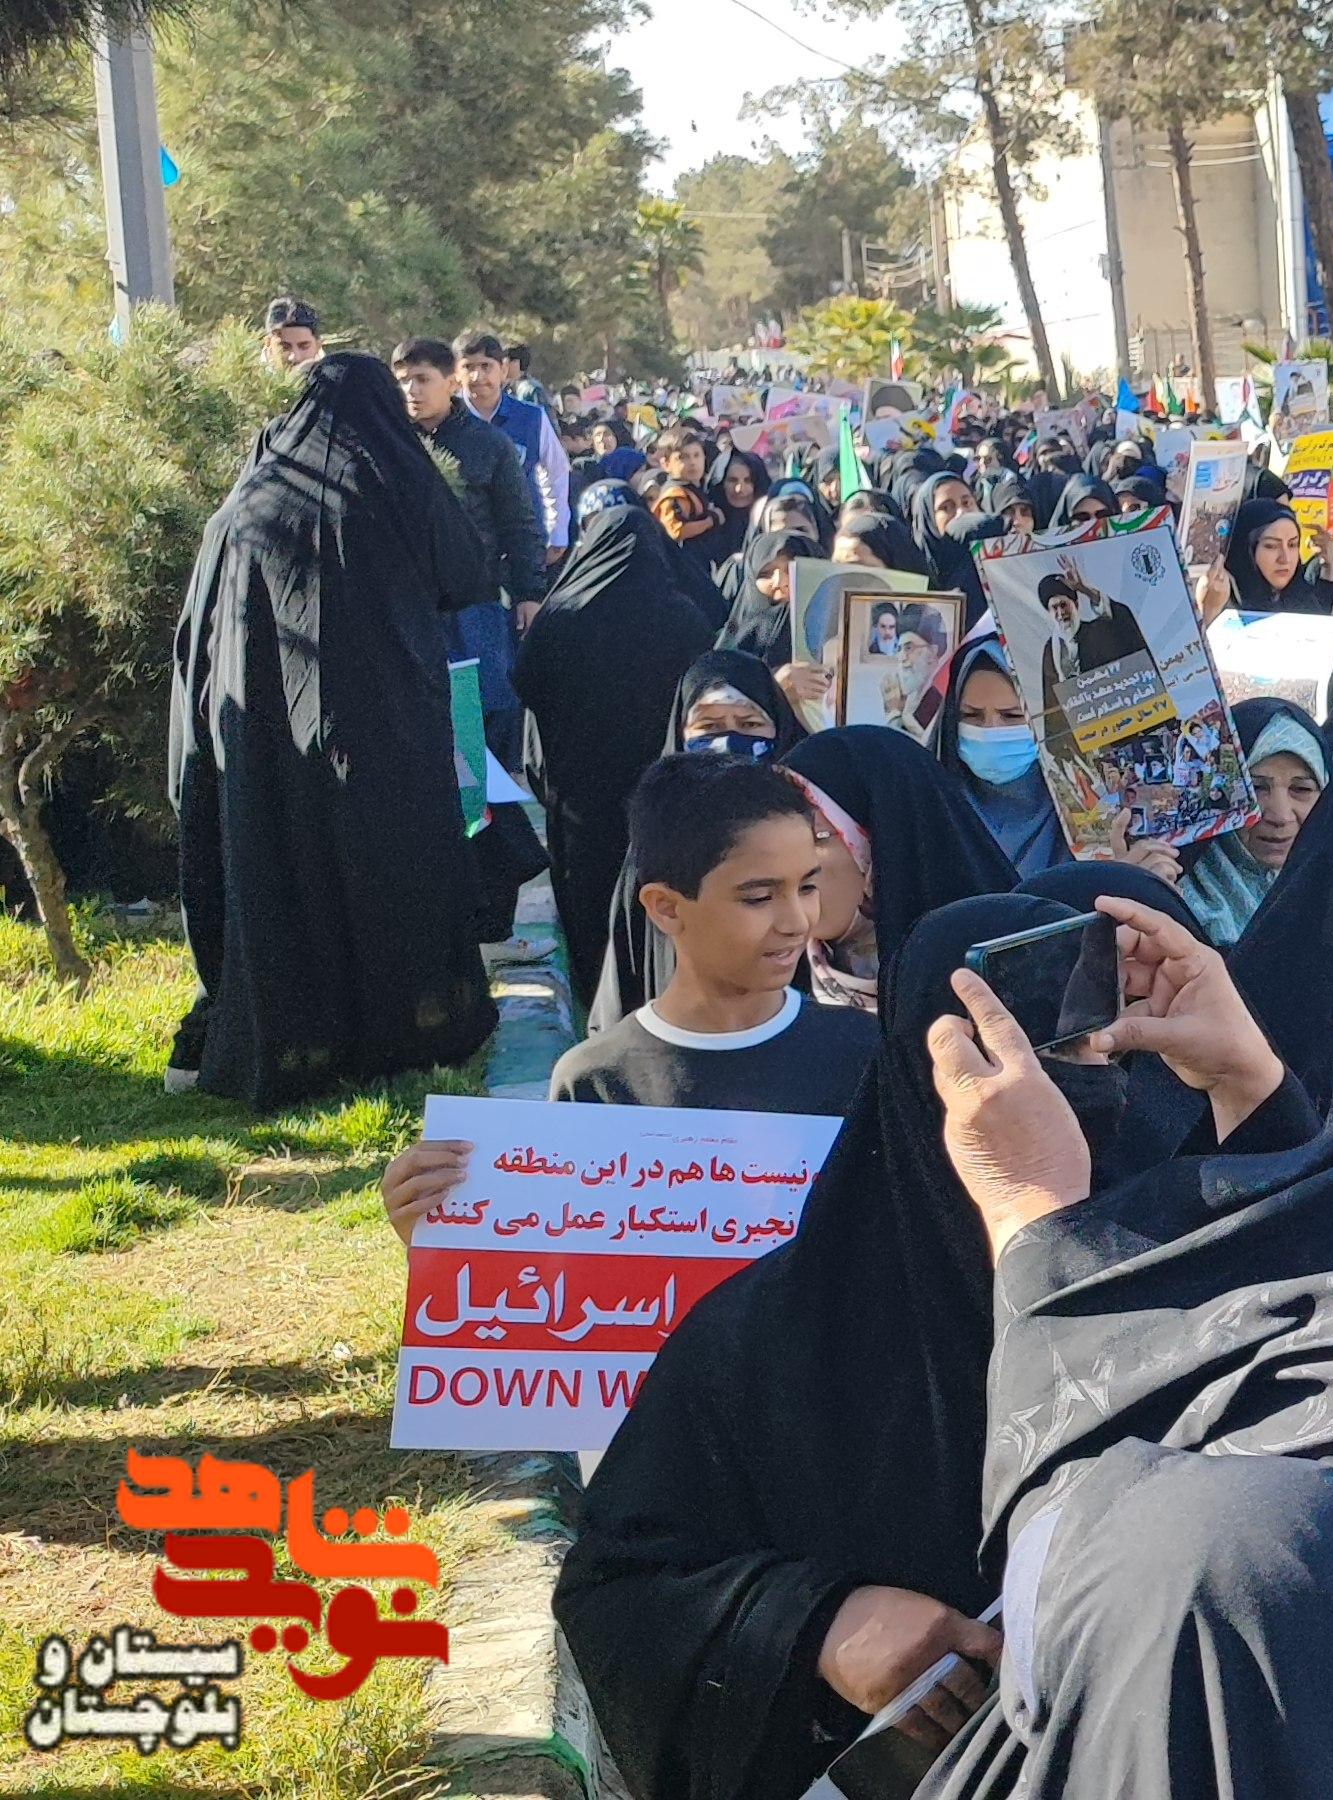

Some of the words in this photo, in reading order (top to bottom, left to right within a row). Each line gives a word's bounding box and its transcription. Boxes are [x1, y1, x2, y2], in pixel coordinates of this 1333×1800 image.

[492, 1146, 577, 1177] منطقه
[579, 1151, 629, 1188] این
[629, 1156, 669, 1189] در
[668, 1159, 704, 1190] هم
[709, 1155, 736, 1184] ها
[426, 1198, 491, 1225] کنند
[492, 1208, 541, 1238] می
[545, 1201, 607, 1239] عمل
[609, 1203, 709, 1242] استکبار
[413, 1261, 678, 1344] اسرائیل
[407, 1364, 583, 1408] DOWN
